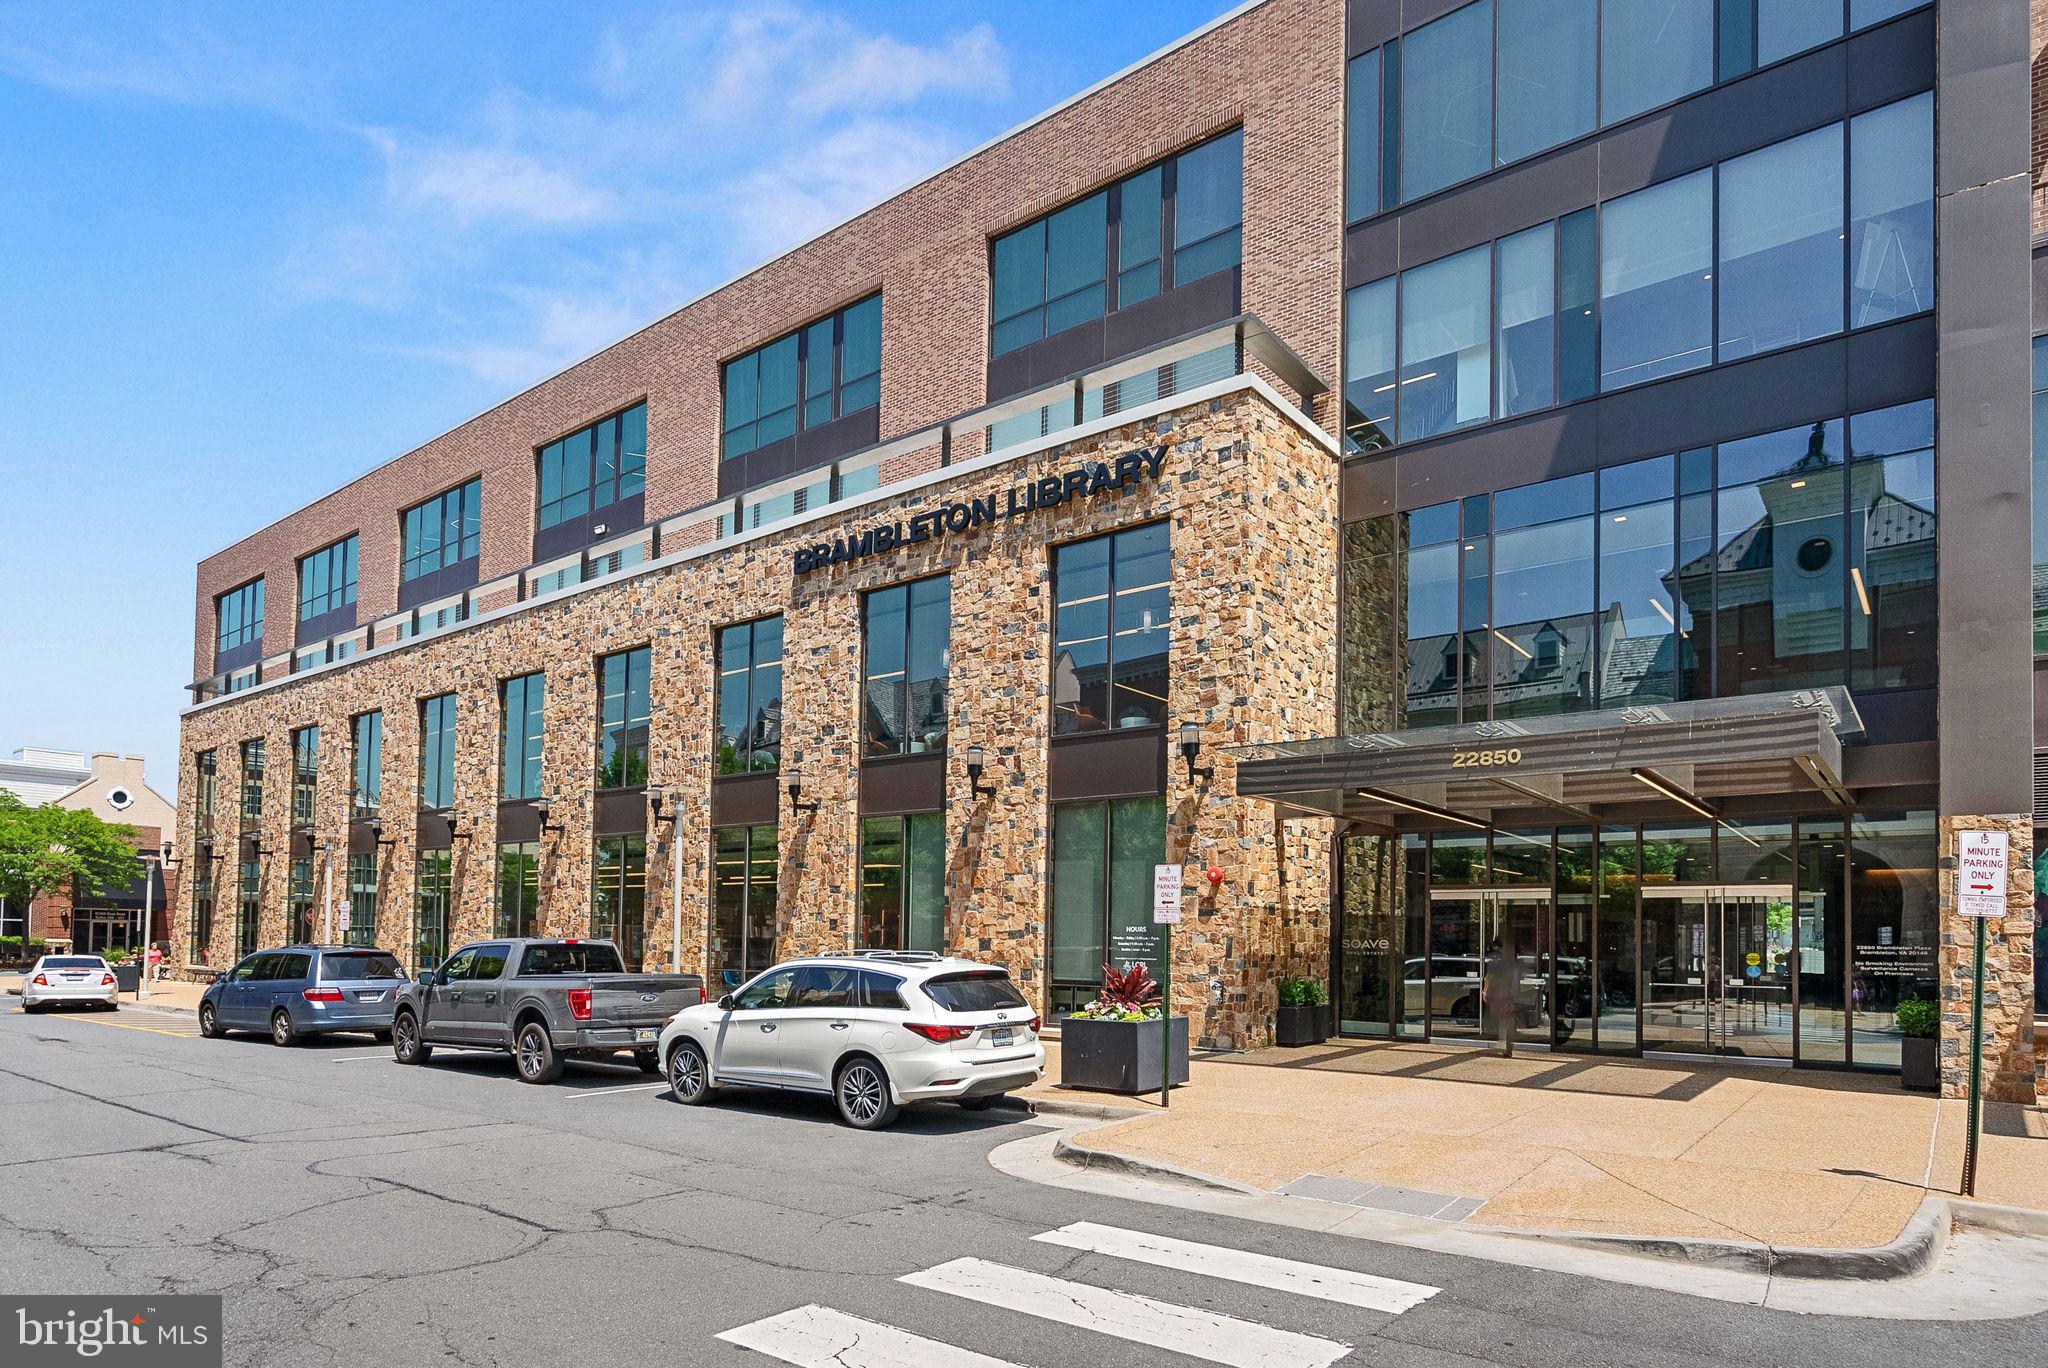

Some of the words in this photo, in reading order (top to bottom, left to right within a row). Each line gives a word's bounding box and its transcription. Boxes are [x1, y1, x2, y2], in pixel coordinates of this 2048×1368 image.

[793, 495, 997, 575] BRAMBLETON
[1007, 445, 1170, 518] LIBRARY
[1452, 748, 1521, 768] 22850
[1980, 834, 1989, 844] 15
[1967, 847, 2001, 857] MINUTE
[1963, 859, 2004, 869] PARKING
[1971, 871, 1995, 880] ONLY
